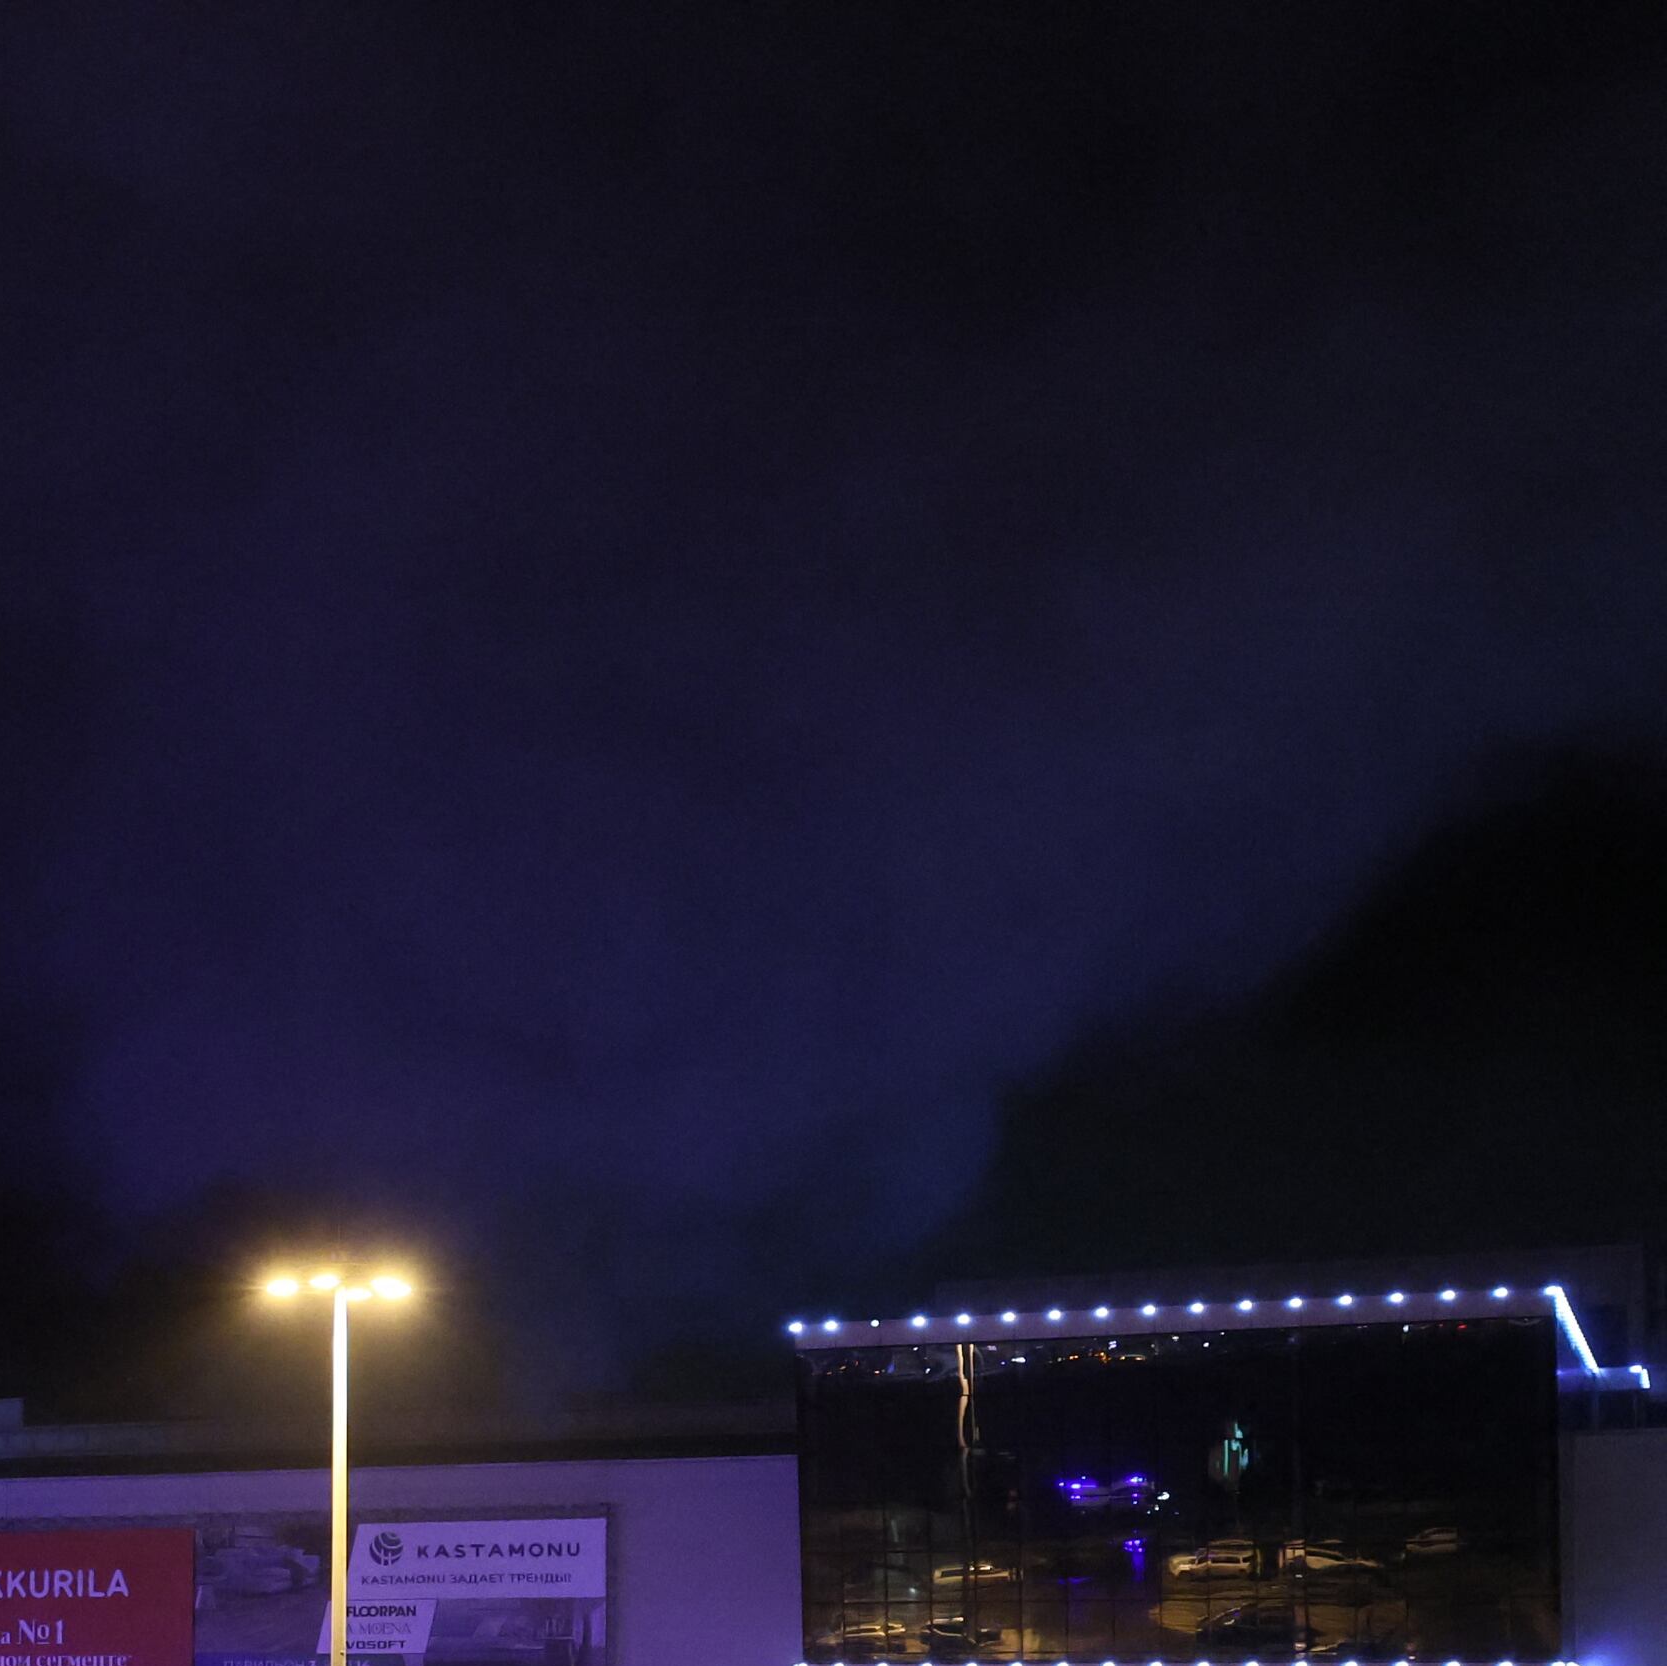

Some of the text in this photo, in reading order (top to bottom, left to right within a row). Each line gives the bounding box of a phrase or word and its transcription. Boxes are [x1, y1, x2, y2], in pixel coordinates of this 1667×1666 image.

[417, 1542, 581, 1559] KASTAMONU
[361, 1575, 446, 1586] KASTAMONU
[450, 1573, 504, 1586] ЗАДАЕТ
[346, 1640, 406, 1649] VOSOFT
